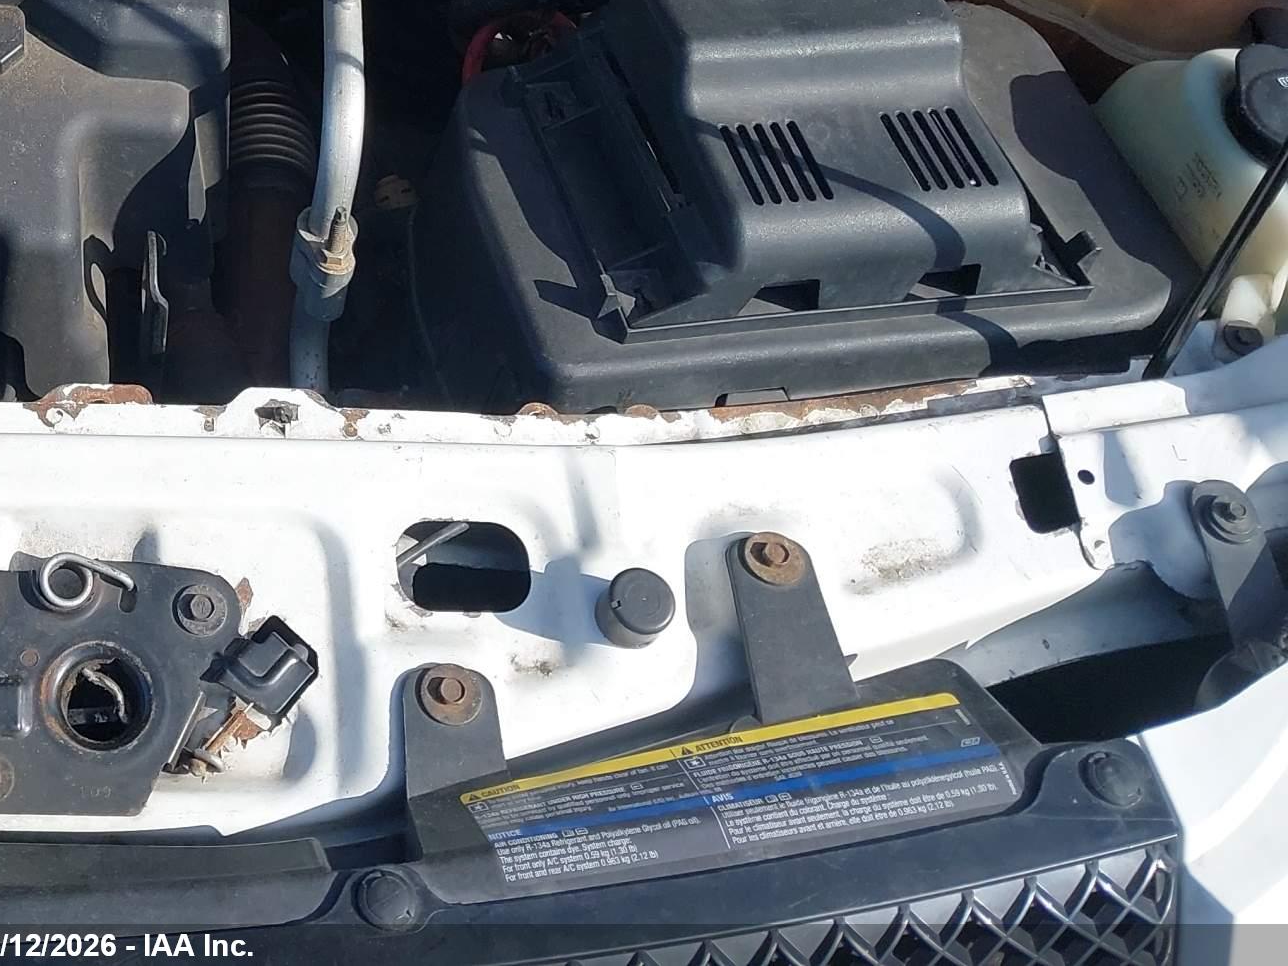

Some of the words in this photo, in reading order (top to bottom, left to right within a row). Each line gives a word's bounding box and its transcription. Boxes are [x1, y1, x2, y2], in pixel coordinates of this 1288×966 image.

[695, 736, 744, 752] ATTENTION
[480, 784, 520, 797] CAUTION
[711, 792, 733, 802] AVIS
[839, 787, 863, 798] R-134a
[488, 828, 521, 840] NOTICE
[729, 826, 743, 835] Pour
[507, 832, 557, 845] CONDITIONING
[510, 845, 525, 854] only
[525, 841, 550, 851] R-134a
[589, 832, 600, 840] and
[732, 835, 747, 844] Pour
[499, 855, 513, 864] The
[514, 851, 537, 863] system
[538, 846, 565, 858] contains
[566, 843, 581, 854] dye.
[582, 840, 605, 852] System
[502, 864, 512, 873] For
[514, 861, 530, 871] front
[531, 859, 545, 869] only
[546, 857, 558, 865] A/C
[559, 853, 583, 864] system
[505, 873, 516, 882] For
[517, 870, 534, 879] front
[534, 868, 547, 877] and
[562, 863, 575, 872] A/C
[576, 860, 599, 871] system
[600, 856, 619, 866] 0.963
[630, 851, 649, 862] (2.12
